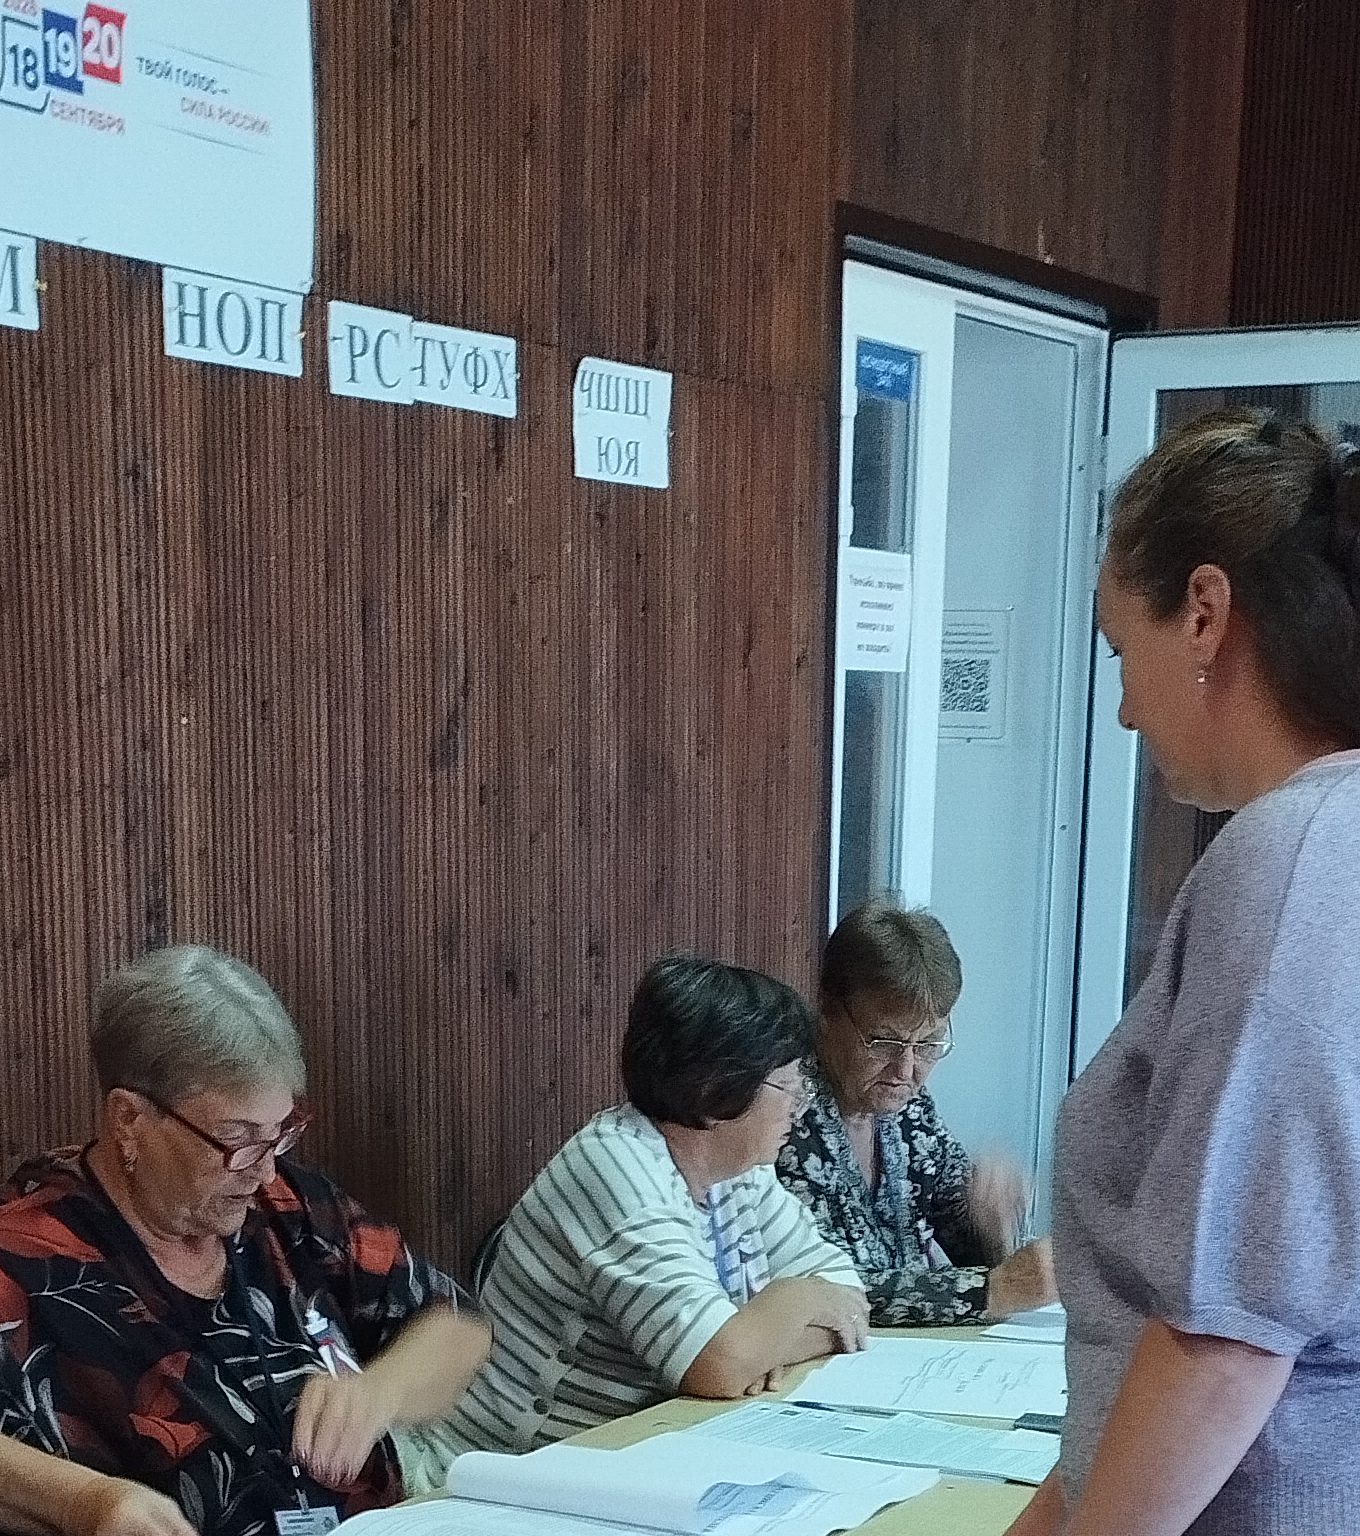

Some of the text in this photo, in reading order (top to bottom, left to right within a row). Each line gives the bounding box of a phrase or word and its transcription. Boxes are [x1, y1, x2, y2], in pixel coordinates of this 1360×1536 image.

[9, 17, 120, 91] 18 19 20
[136, 56, 172, 82] ТВОЙ
[50, 100, 125, 134] СЕНТЯБРЯ
[173, 280, 288, 363] НОП
[596, 436, 640, 477] ЮЯ
